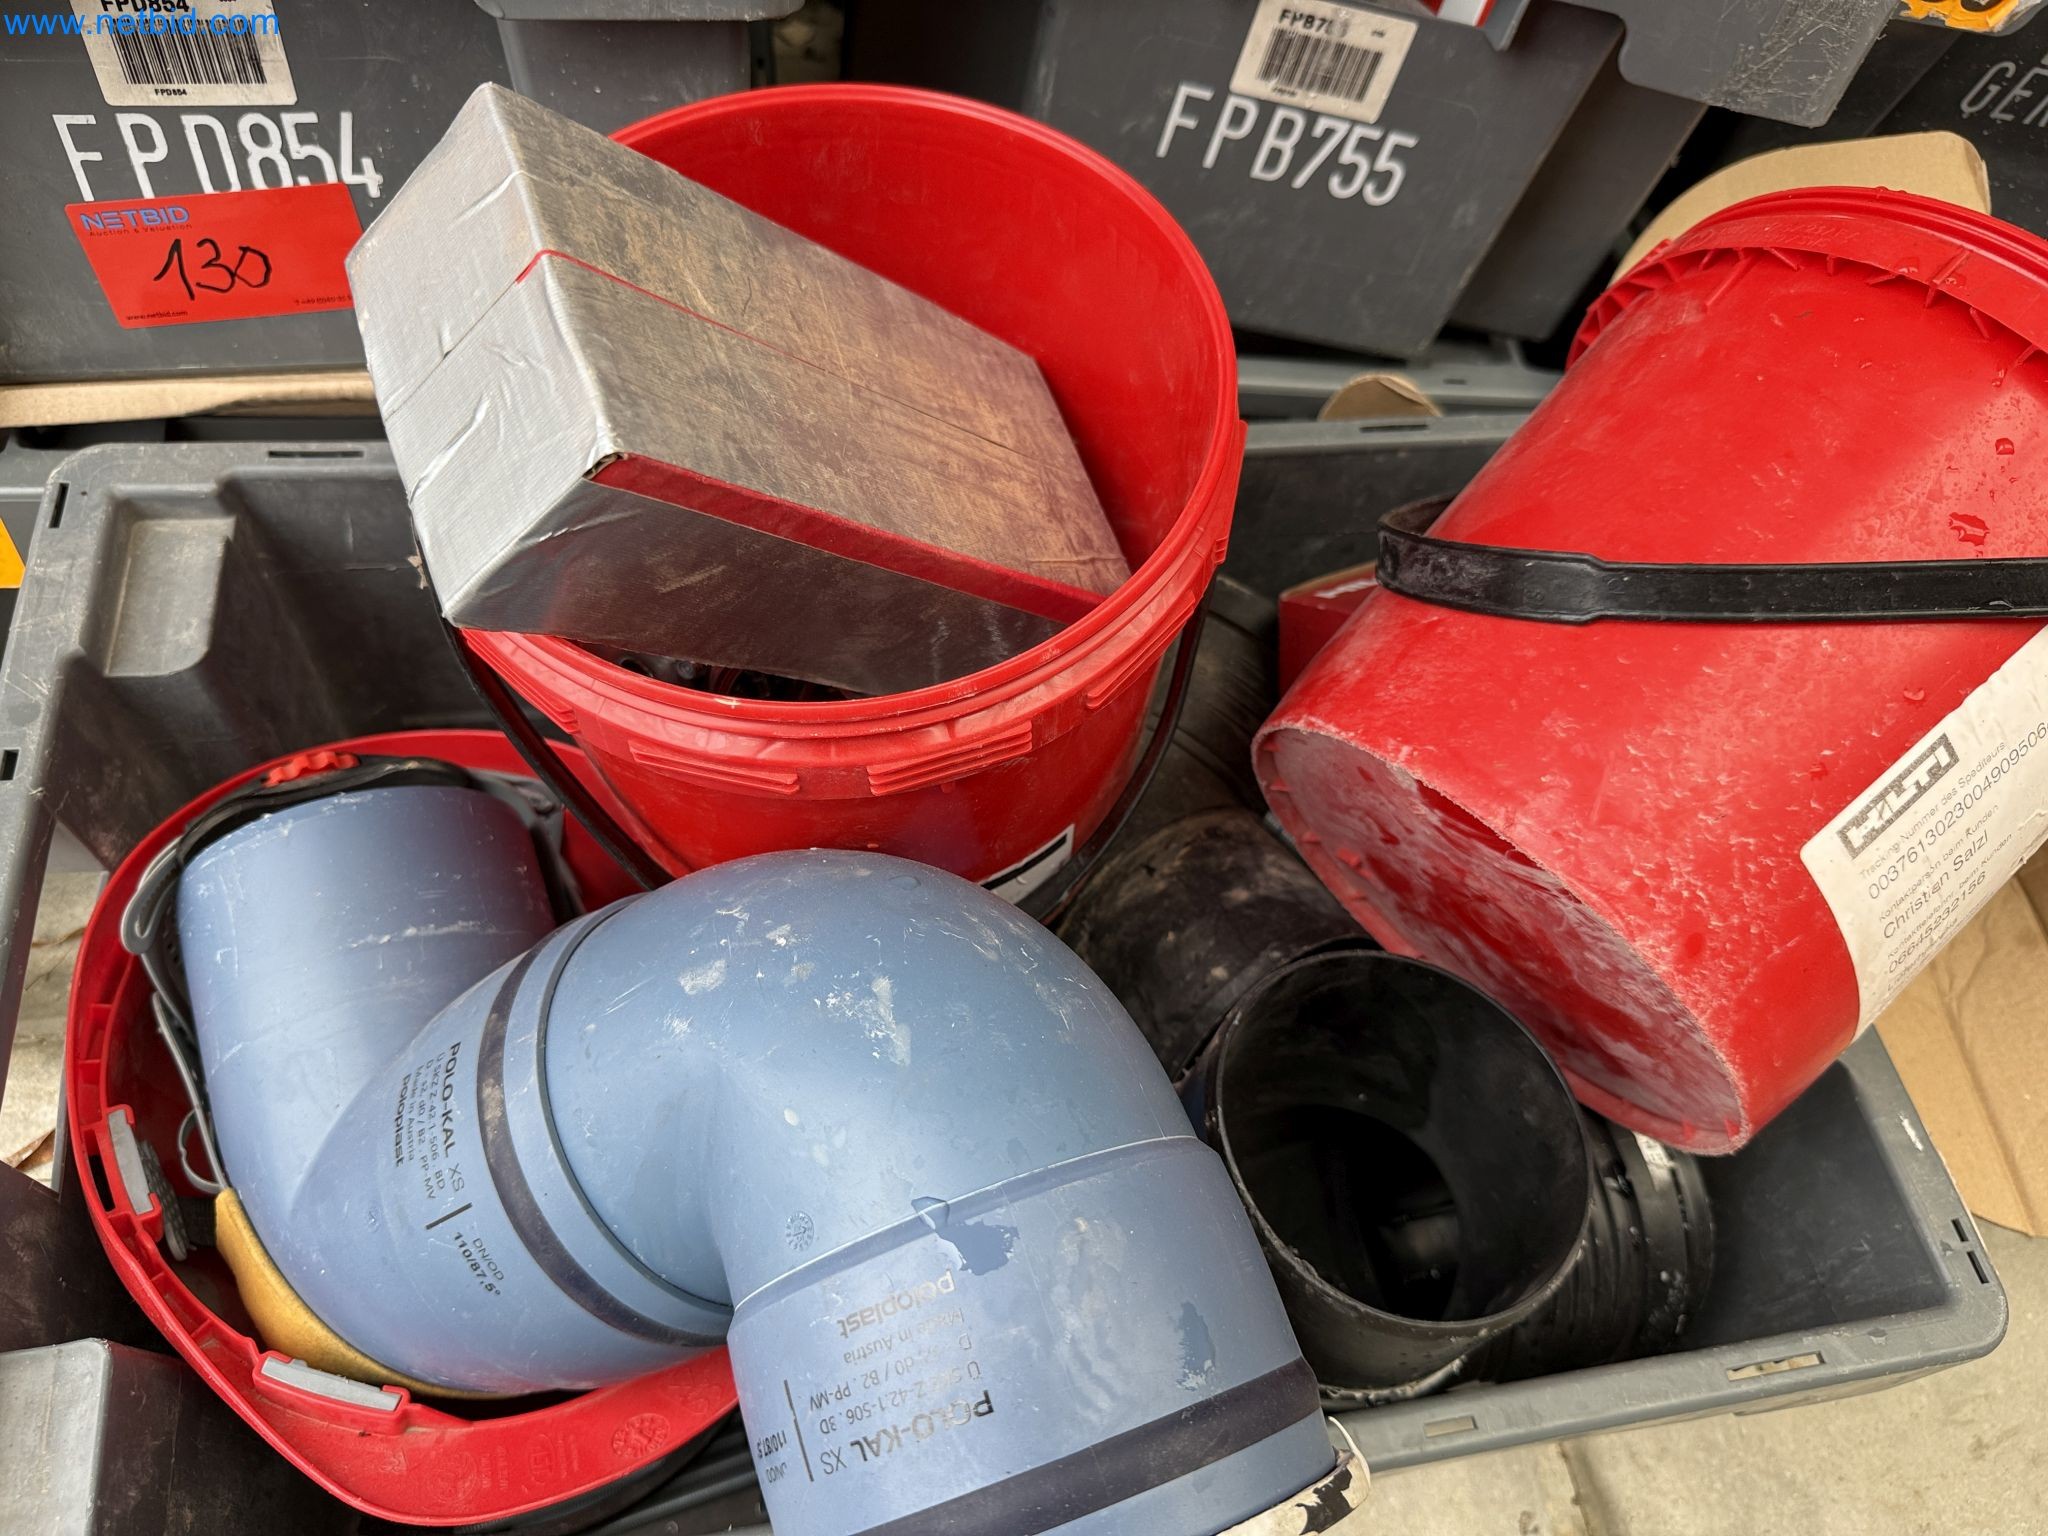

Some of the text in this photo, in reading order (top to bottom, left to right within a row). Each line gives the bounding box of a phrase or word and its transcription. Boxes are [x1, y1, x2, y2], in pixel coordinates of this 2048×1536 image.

[103, 0, 190, 12] FPD854
[155, 88, 187, 96] FPD854
[53, 111, 383, 201] FPD854
[1155, 81, 1420, 207] FPB755
[80, 206, 190, 230] NETBID
[153, 238, 272, 300] 130
[1941, 788, 1958, 806] des
[1958, 742, 2006, 788] Spediteurs
[1845, 742, 1953, 852] HILTI
[1868, 721, 2048, 899] 0037613023004909506
[1965, 804, 1999, 838] Kunden
[1884, 830, 1988, 938] Christian Salzl
[394, 1073, 412, 1167] poloplast
[442, 1041, 465, 1192] POLO-KAL XS
[407, 1117, 415, 1161] Austria
[472, 1238, 504, 1280] DN/OD
[837, 1268, 955, 1338] poloplast
[843, 1334, 893, 1365] Austria
[967, 1360, 981, 1380] Ü
[809, 1381, 852, 1412] PP-MV
[863, 1369, 880, 1389] B2
[846, 1380, 926, 1425] Z-42.1-506
[820, 1446, 848, 1475] XS
